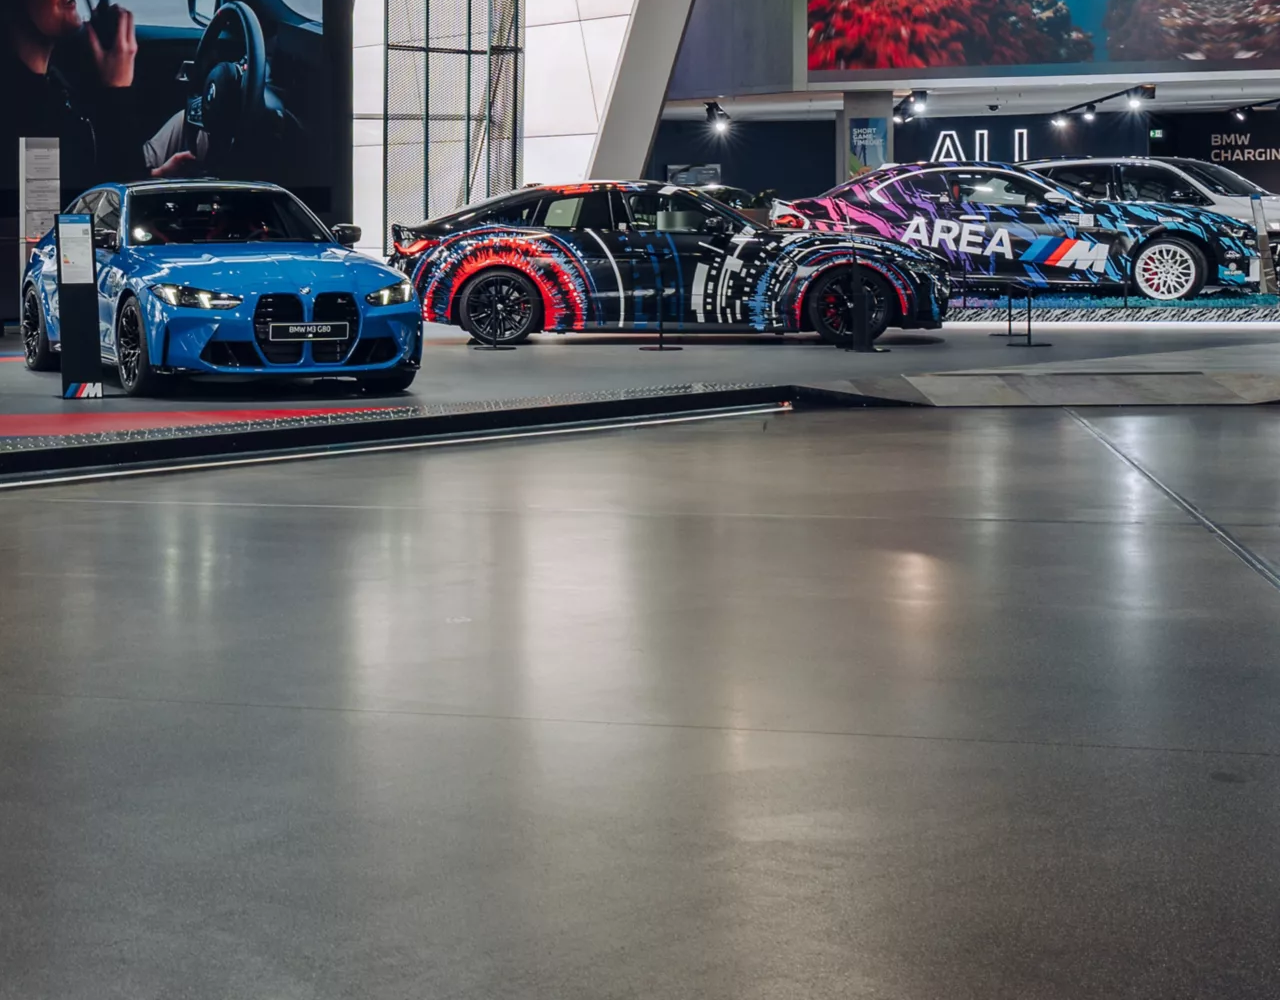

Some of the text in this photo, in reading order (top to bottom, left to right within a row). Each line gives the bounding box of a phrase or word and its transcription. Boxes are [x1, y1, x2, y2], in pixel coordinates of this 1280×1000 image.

[1210, 133, 1251, 146] BMW
[900, 216, 1110, 273] AREA M
[288, 325, 332, 333] BMW M3 G80
